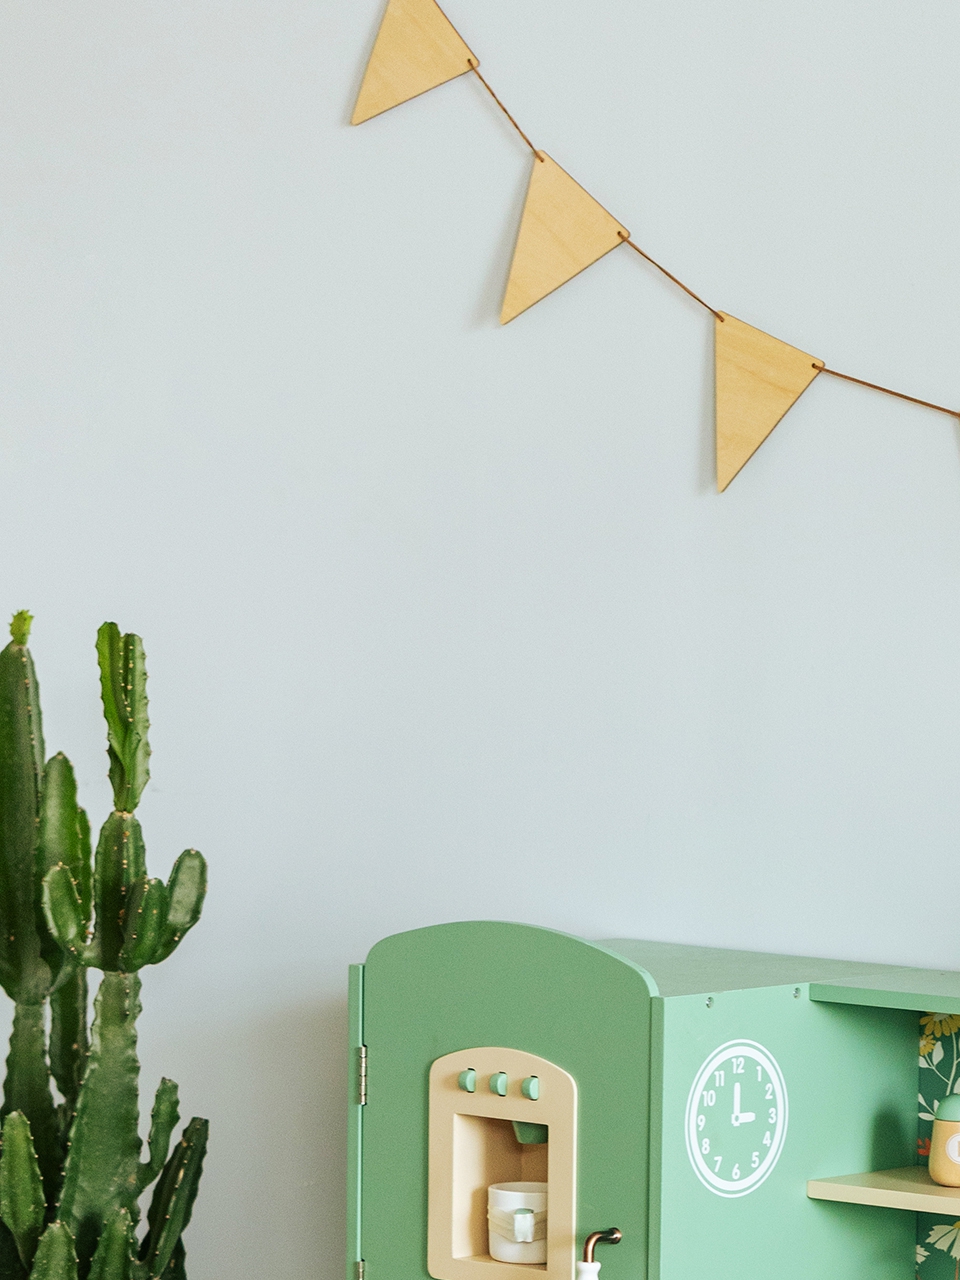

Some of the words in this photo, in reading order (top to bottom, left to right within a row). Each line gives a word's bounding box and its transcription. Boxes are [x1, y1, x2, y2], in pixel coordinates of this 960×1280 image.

[731, 1057, 744, 1073] 12
[714, 1070, 724, 1087] 11
[756, 1066, 762, 1081] 1
[702, 1090, 716, 1106] 10
[765, 1083, 773, 1099] 2
[698, 1115, 705, 1131] 9
[768, 1108, 776, 1123] 3
[702, 1138, 710, 1154] 8
[762, 1131, 771, 1147] 4
[714, 1156, 722, 1172] 7
[751, 1152, 759, 1168] 5
[732, 1163, 740, 1179] 6
